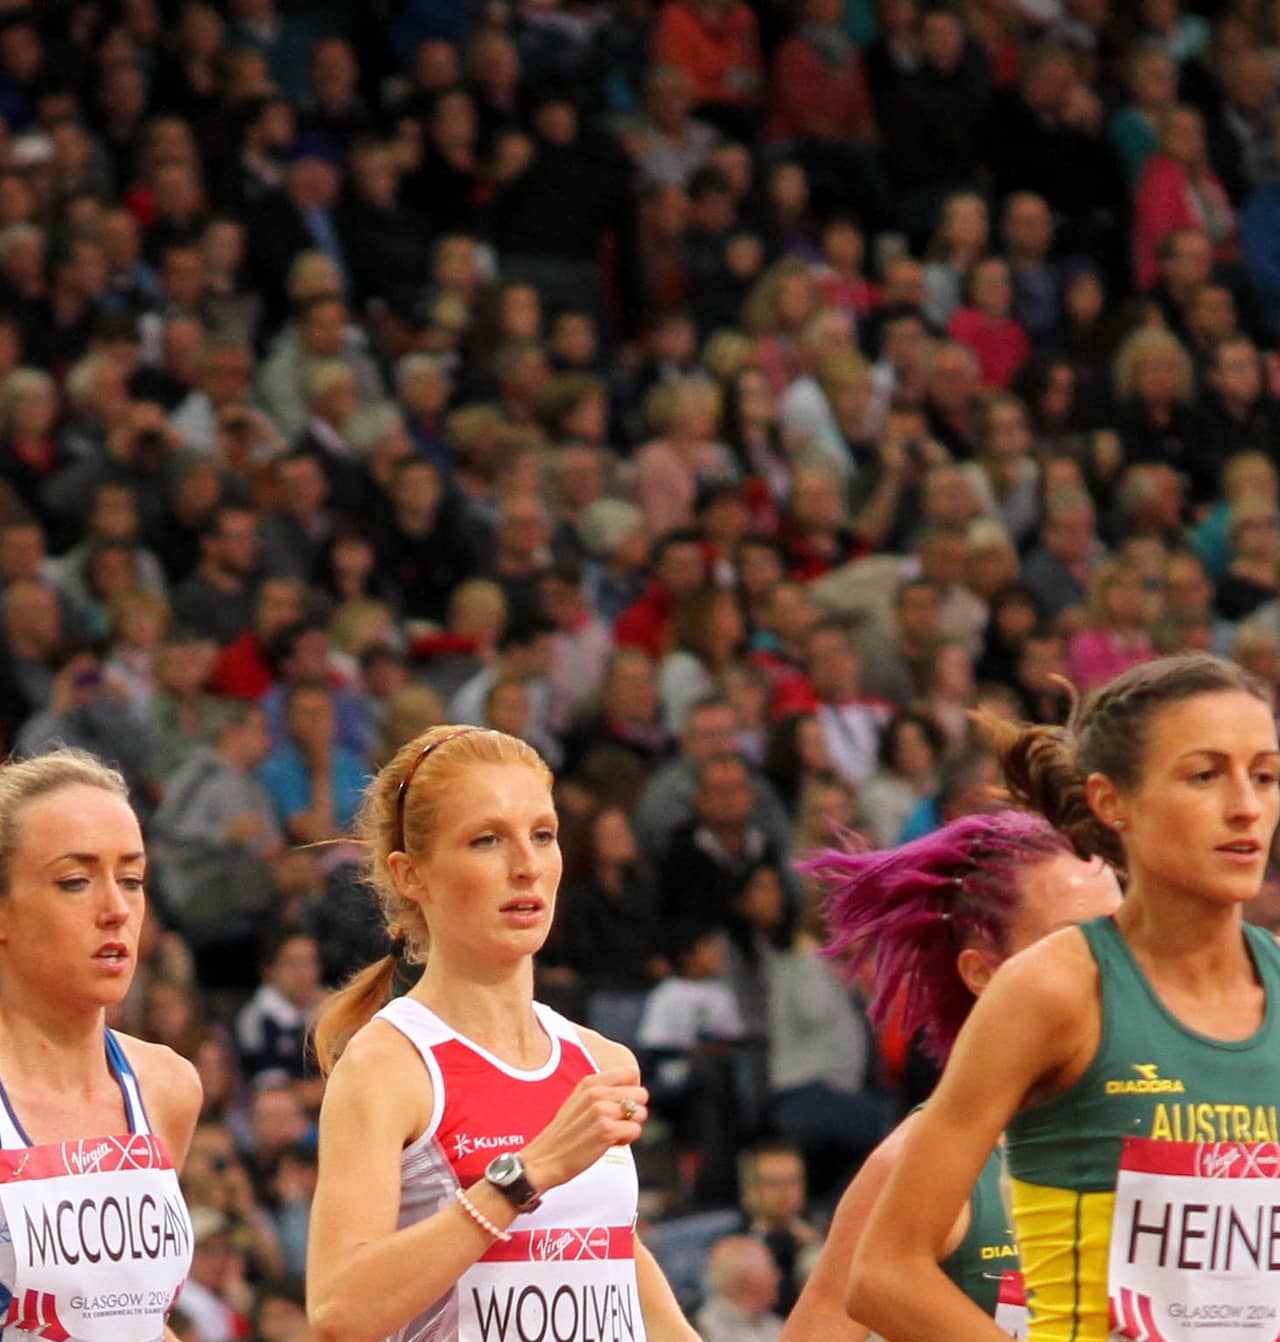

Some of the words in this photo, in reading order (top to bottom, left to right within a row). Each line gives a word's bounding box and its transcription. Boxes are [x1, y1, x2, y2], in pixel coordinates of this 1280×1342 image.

[1105, 1079, 1185, 1094] DIADORA
[474, 1135, 524, 1149] KUKRI
[72, 1139, 113, 1174] Virgin
[23, 1193, 189, 1268] MCCOLGAN
[537, 1227, 575, 1260] Virgin
[70, 1293, 143, 1310] GLASGOW
[1167, 1302, 1244, 1320] GLASGOW
